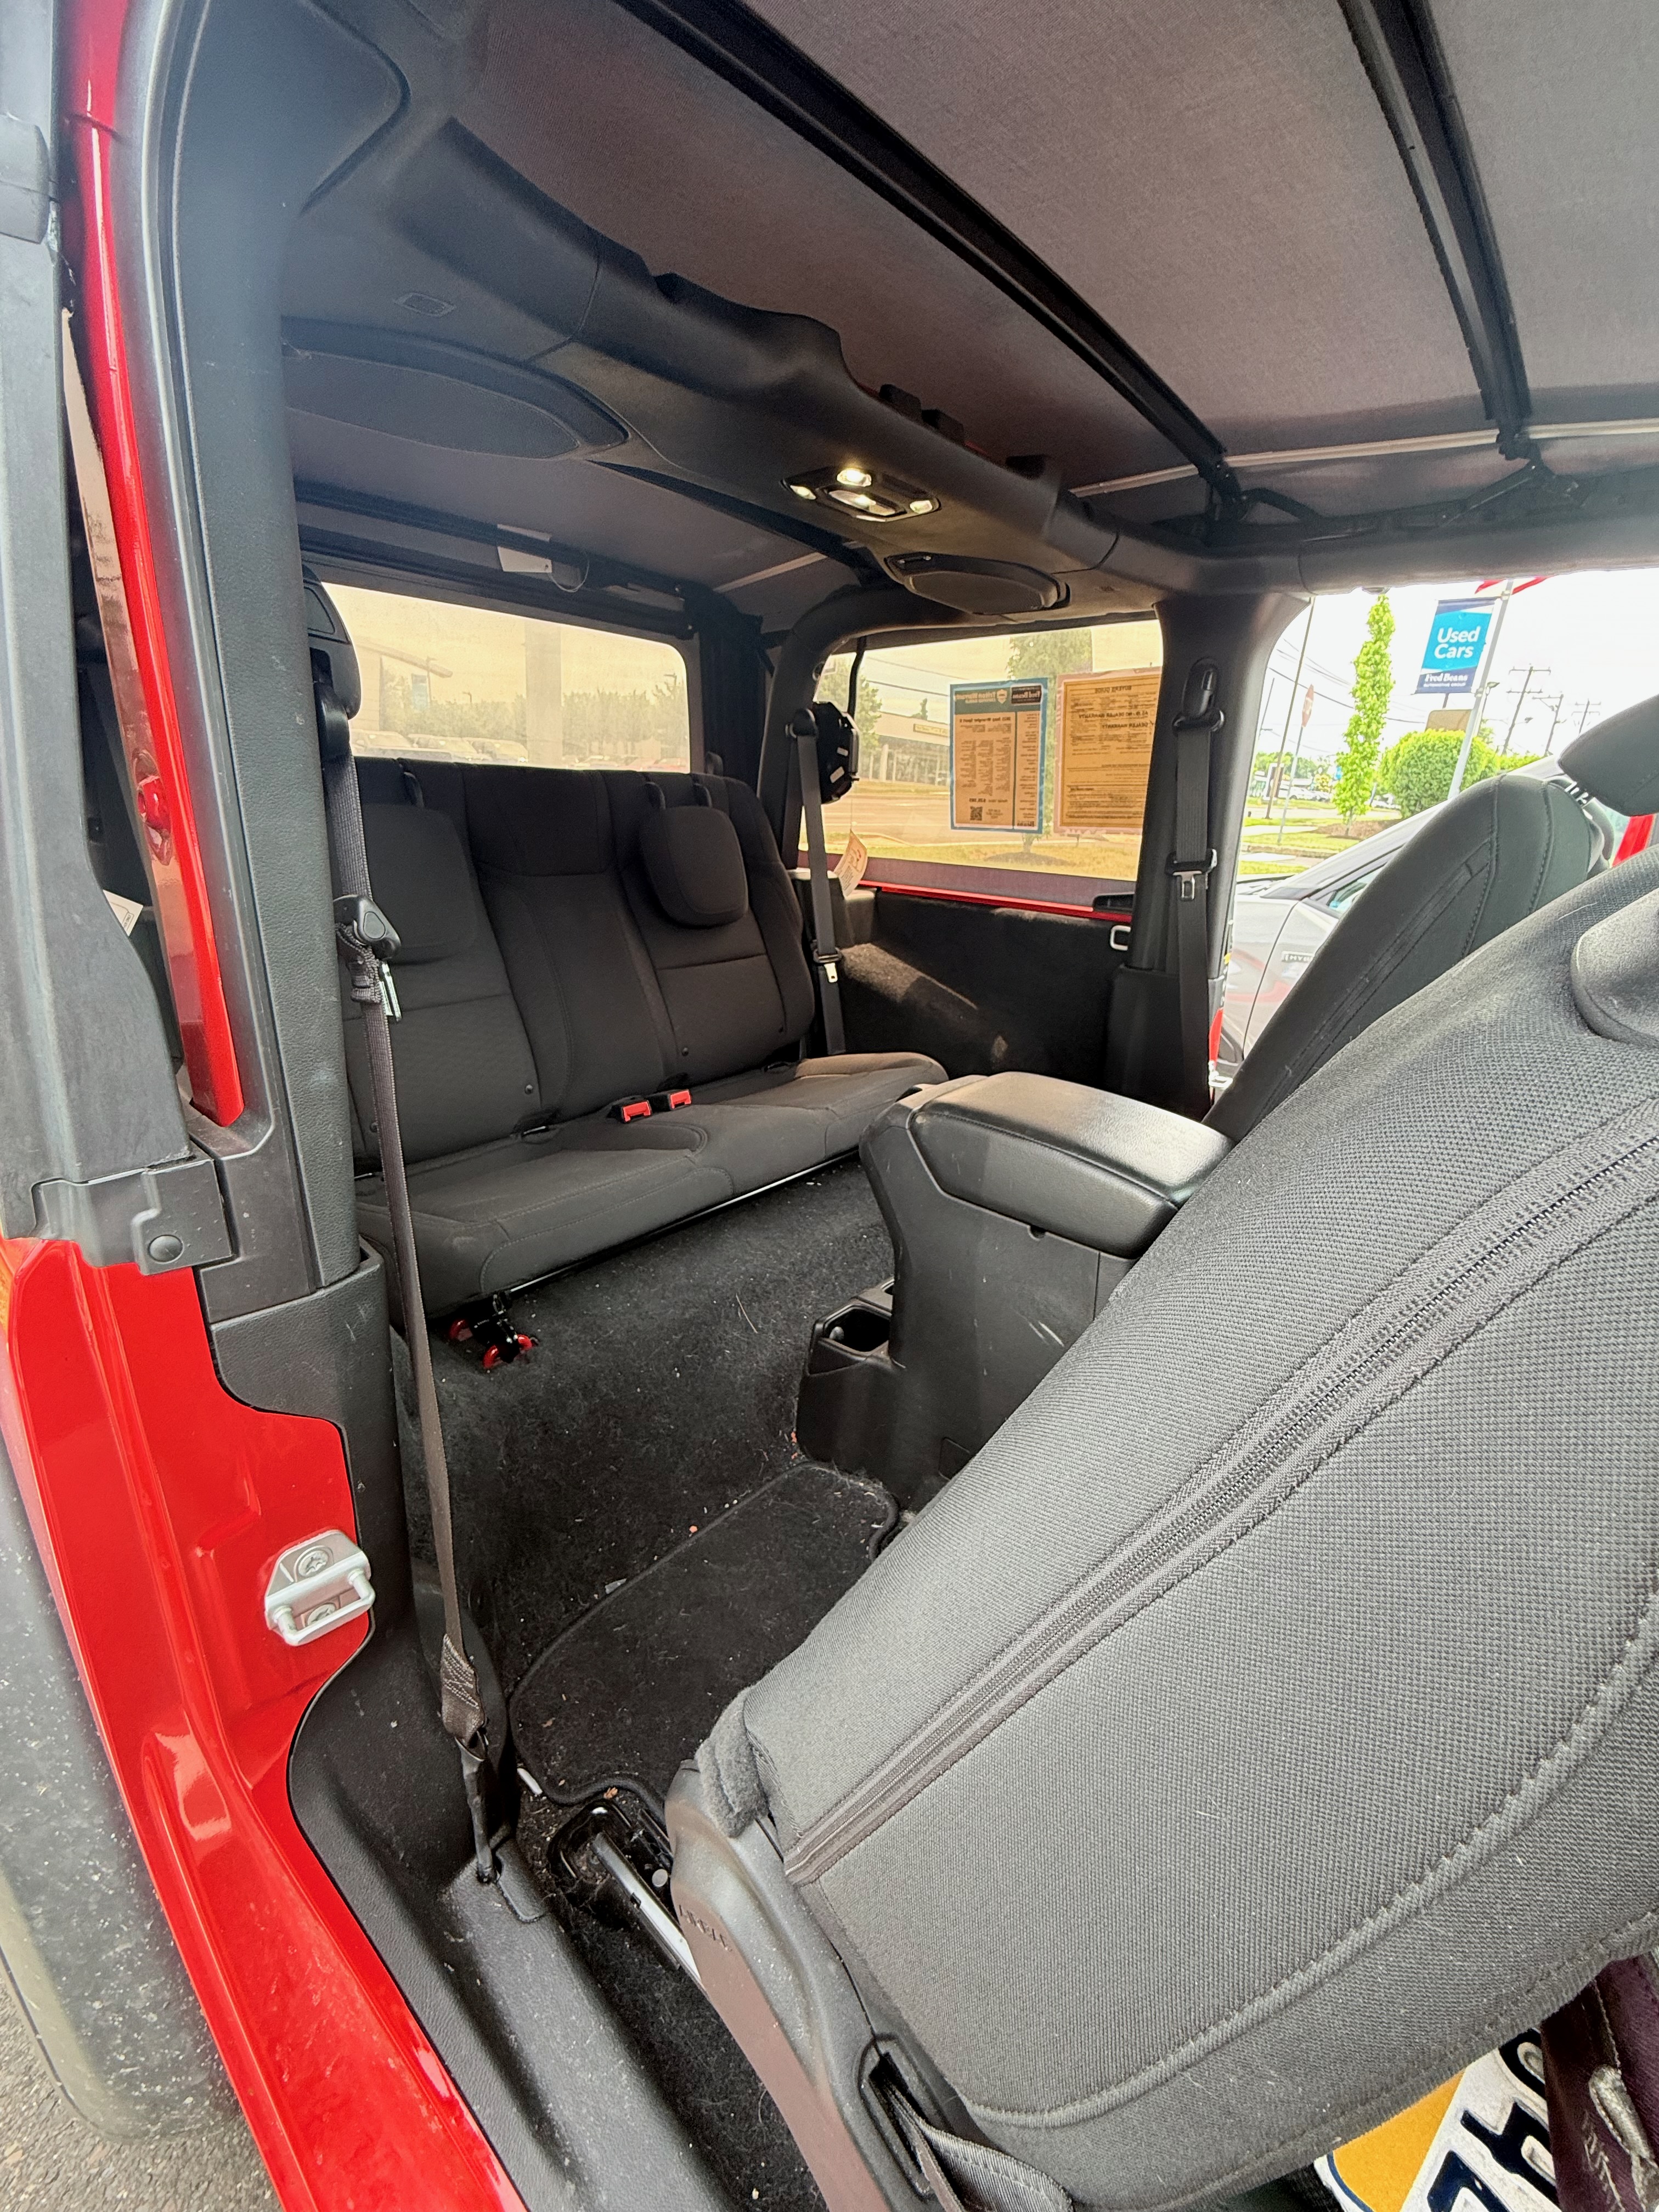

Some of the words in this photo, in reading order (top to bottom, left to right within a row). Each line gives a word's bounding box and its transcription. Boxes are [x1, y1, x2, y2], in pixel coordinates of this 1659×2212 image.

[1437, 625, 1481, 644] Used
[1434, 643, 1474, 659] Cars
[1425, 673, 1443, 682] Fred
